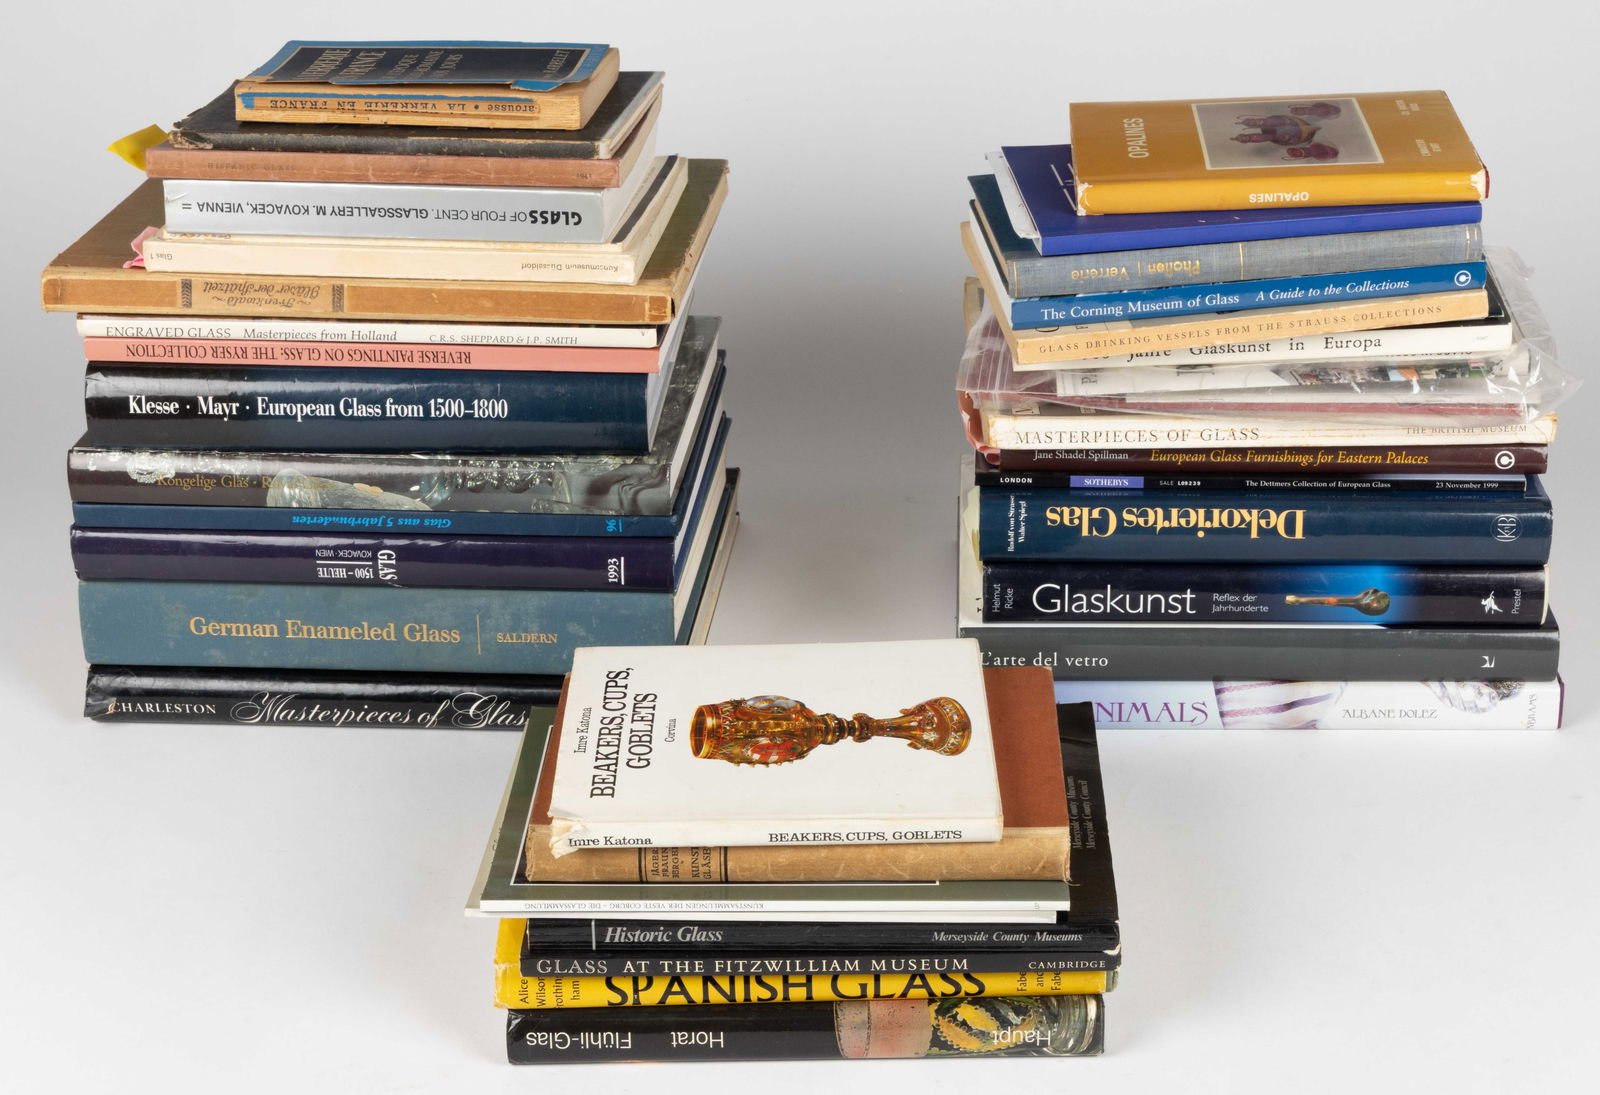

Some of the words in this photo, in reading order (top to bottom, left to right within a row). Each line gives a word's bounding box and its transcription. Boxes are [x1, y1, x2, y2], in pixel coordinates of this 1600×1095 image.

[270, 100, 327, 110] FRANCE
[1122, 118, 1150, 158] OPALINES
[1250, 191, 1309, 203] OPALINES
[197, 202, 244, 214] VIENNA
[246, 202, 310, 216] KOVACEK,
[313, 205, 326, 216] M.
[330, 205, 428, 219] GLASSGALLERY
[432, 208, 468, 220] CENT.
[471, 210, 506, 222] FOUR
[510, 212, 528, 222] OF
[530, 210, 582, 226] GLASS
[1256, 290, 1264, 302] A
[1270, 287, 1305, 300] Guide
[1308, 288, 1320, 298] to
[1324, 284, 1342, 296] the
[1346, 279, 1410, 294] Collections
[1040, 309, 1066, 321] The
[1070, 304, 1123, 316] Corning
[1128, 299, 1183, 313] Museum
[1188, 295, 1202, 308] of
[1205, 293, 1240, 306] Glass
[106, 327, 184, 338] ENGRAVED
[187, 328, 231, 338] GLASS
[244, 328, 316, 342] Masterpieces
[320, 329, 347, 340] from
[351, 330, 397, 342] Holland
[429, 334, 458, 343] C.R.S.
[460, 335, 514, 344] SHEPPARD
[526, 336, 544, 345] J.P.
[546, 336, 578, 345] SMITH
[1039, 342, 1079, 354] GLASS
[1086, 334, 1150, 350] DRINKING
[1157, 330, 1210, 342] VESSELS
[1216, 325, 1251, 337] FROM
[1257, 322, 1283, 332] THE
[1289, 316, 1347, 329] STRAUSS
[1352, 304, 1442, 322] COLLECTIONS
[126, 343, 207, 359] COLLECTION
[211, 345, 248, 360] RYSER
[252, 346, 276, 360] THE
[280, 346, 320, 361] GLASS:
[1190, 340, 1270, 356] Glaskunst
[1288, 338, 1304, 351] in
[1324, 336, 1382, 352] Europa
[325, 348, 344, 362] ON
[348, 350, 414, 362] PAINTINGS
[418, 350, 472, 364] REVERSE
[128, 395, 180, 416] Klesse
[197, 396, 240, 421] Mayr
[256, 397, 336, 422] European
[339, 397, 382, 418] Glass
[385, 398, 424, 418] from
[1015, 430, 1158, 446] MASTERPIECES
[1166, 429, 1191, 442] OF
[1200, 427, 1261, 442] GLASS
[1480, 424, 1527, 434] MUSEUM
[1033, 450, 1054, 462] Jane
[1055, 450, 1086, 460] Shadel
[1088, 450, 1128, 462] Spillman
[1151, 450, 1206, 464] European
[1210, 450, 1242, 462] Glass
[1246, 450, 1314, 466] Furnishings
[1316, 450, 1334, 466] for
[1336, 450, 1382, 464] Eastern
[1386, 452, 1429, 464] Palaces
[157, 474, 217, 491] Kongelige
[220, 476, 249, 488] Glas
[1246, 480, 1259, 488] The
[1260, 480, 1292, 488] Dettmers
[1292, 480, 1328, 488] Collection
[1338, 481, 1371, 490] European
[292, 516, 386, 528] Jahrhunderten
[387, 518, 396, 527] 5
[398, 518, 421, 527] aus
[425, 518, 452, 528] Glas
[606, 520, 616, 532] 96
[1046, 506, 1118, 538] Glas
[1123, 507, 1307, 540] Dekoriertes
[316, 549, 334, 557] WIEN
[338, 550, 372, 558] KOVACEK
[316, 567, 347, 578] HEUTE
[377, 550, 398, 580] GLAS
[608, 558, 620, 583] 1993
[355, 567, 374, 579] 1500
[992, 584, 1000, 612] Helmut
[1004, 588, 1014, 609] Ricke
[1032, 584, 1196, 614] Glaskunst
[1213, 593, 1240, 602] Reflex
[1242, 594, 1258, 602] der
[1511, 588, 1522, 614] Prestel
[1212, 604, 1270, 613] Jahrhunderte
[190, 616, 280, 638] German
[286, 620, 398, 642] Enameled
[403, 623, 460, 644] Glass
[496, 632, 558, 644] SALDERN
[1032, 652, 1058, 666] del
[1065, 655, 1108, 667] vetro
[602, 668, 634, 712] CUPS,
[111, 701, 217, 715] CHARLESTON
[230, 692, 414, 728] Masterpieces
[417, 699, 453, 728] of
[1343, 708, 1396, 720] ALBANE
[1399, 708, 1438, 720] DOLEZ
[576, 706, 592, 734] Katona
[626, 692, 658, 770] GOBLETS
[664, 718, 676, 743] Corvina
[574, 736, 588, 754] Imre
[590, 714, 628, 798] BEAKERS,
[568, 836, 600, 847] Imre
[604, 836, 653, 846] Katona
[768, 832, 844, 843] BEAKERS,
[846, 831, 888, 842] CUPS,
[892, 830, 962, 841] GOBLETS
[605, 927, 672, 944] Historic
[677, 926, 723, 942] Glass
[932, 931, 988, 944] Merseyside
[992, 931, 1030, 944] County
[1034, 931, 1083, 942] Museums
[536, 959, 608, 974] GLASS
[623, 960, 650, 974] AT
[660, 960, 705, 973] THE
[714, 959, 860, 973] FITZWILLIAM
[870, 958, 968, 972] MUSEUM
[1028, 960, 1106, 970] CAMBRIDGE
[518, 978, 529, 1005] Alice
[605, 975, 814, 1007] SPANISH
[830, 973, 986, 1000] GLASS
[526, 1032, 632, 1050] Flühli-Glas
[671, 1031, 724, 1048] Horat
[992, 1030, 1050, 1046] Haupt
